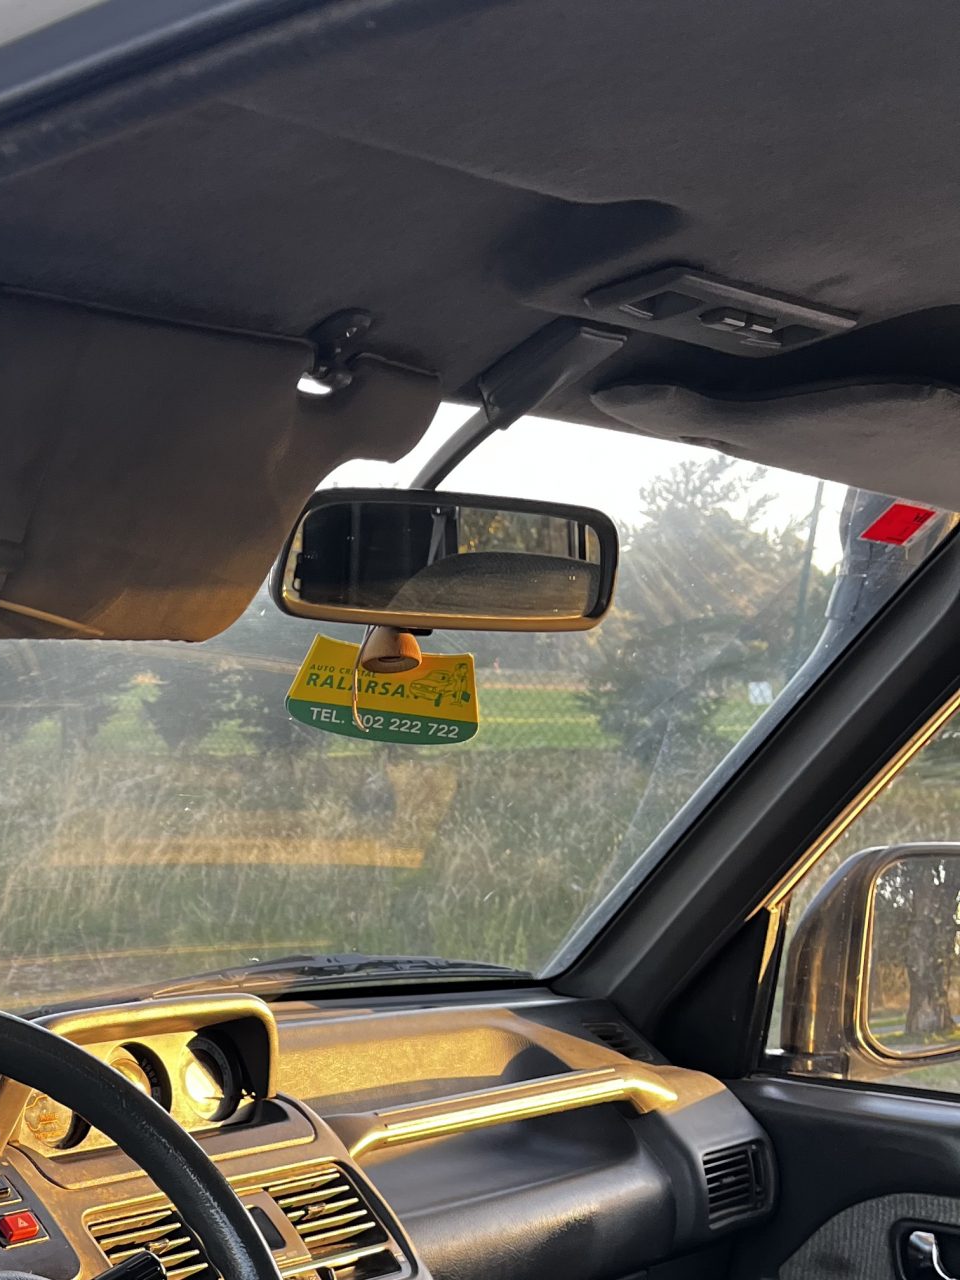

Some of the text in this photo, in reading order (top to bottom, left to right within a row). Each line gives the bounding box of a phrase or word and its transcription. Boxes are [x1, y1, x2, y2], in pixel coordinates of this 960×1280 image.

[310, 664, 376, 679] AUTO CRITAL
[306, 672, 405, 698] RALARSA
[310, 707, 344, 724] TEL.
[389, 718, 421, 734] 222
[428, 722, 459, 739] 722
